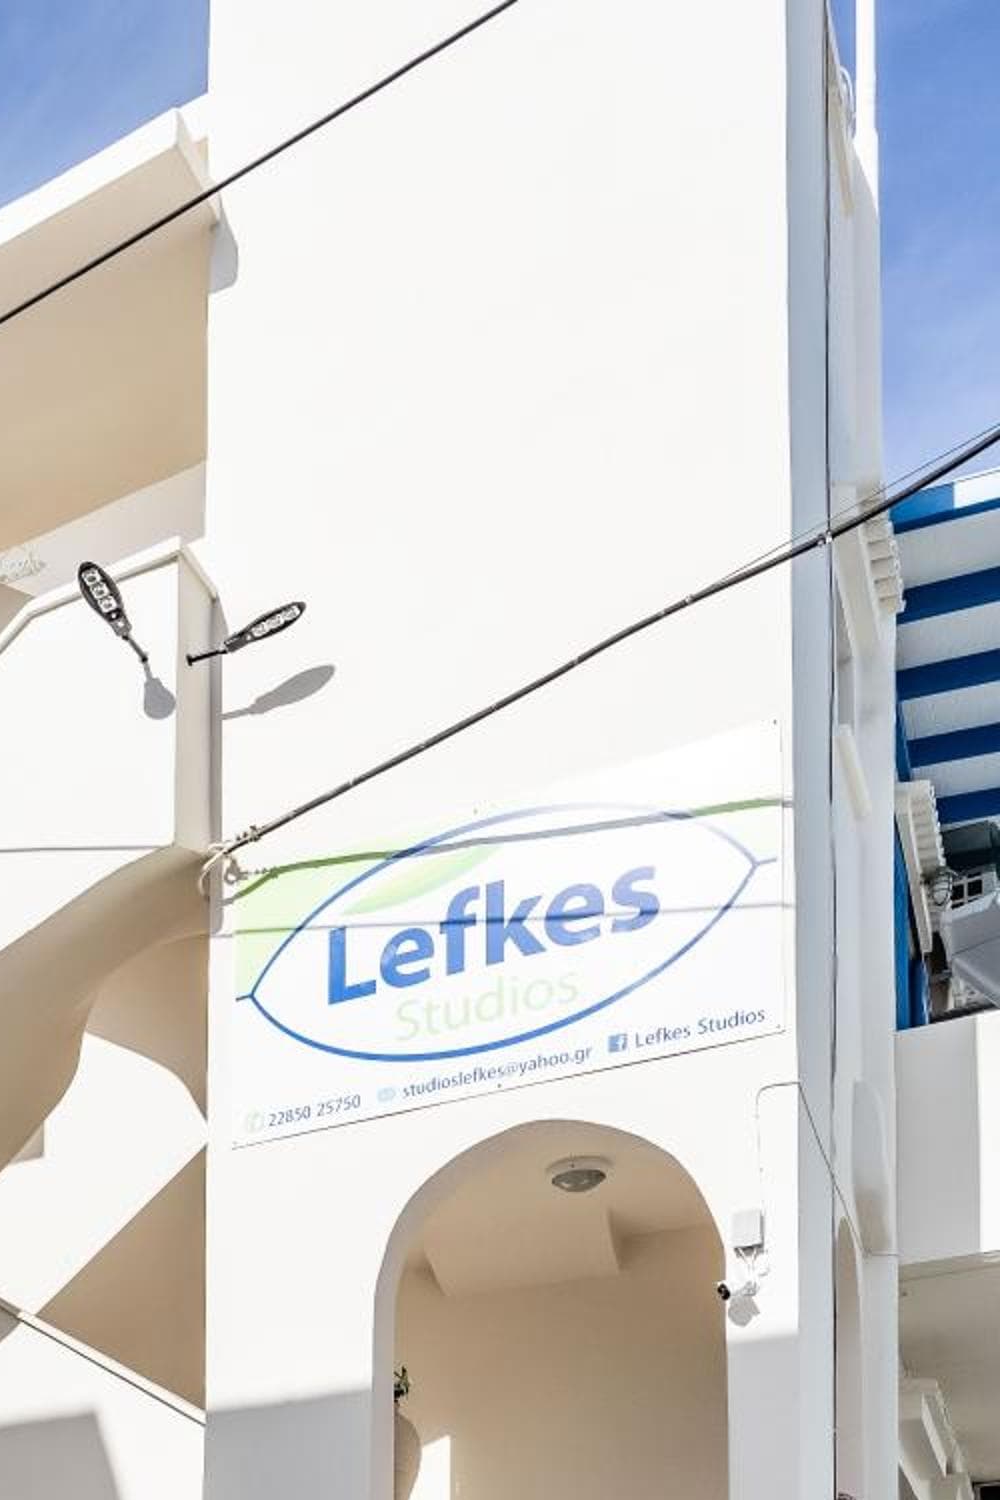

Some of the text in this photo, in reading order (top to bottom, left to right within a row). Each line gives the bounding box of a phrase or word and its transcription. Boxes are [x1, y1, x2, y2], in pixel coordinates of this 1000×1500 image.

[327, 865, 661, 1006] Lefkes
[394, 971, 580, 1042] Studios
[268, 1105, 312, 1128] 22850
[316, 1094, 362, 1118] 25750
[402, 1047, 593, 1098] studioslefkes@yahoo.gr
[634, 1026, 691, 1049] Lefkes
[697, 1008, 766, 1036] Studios
